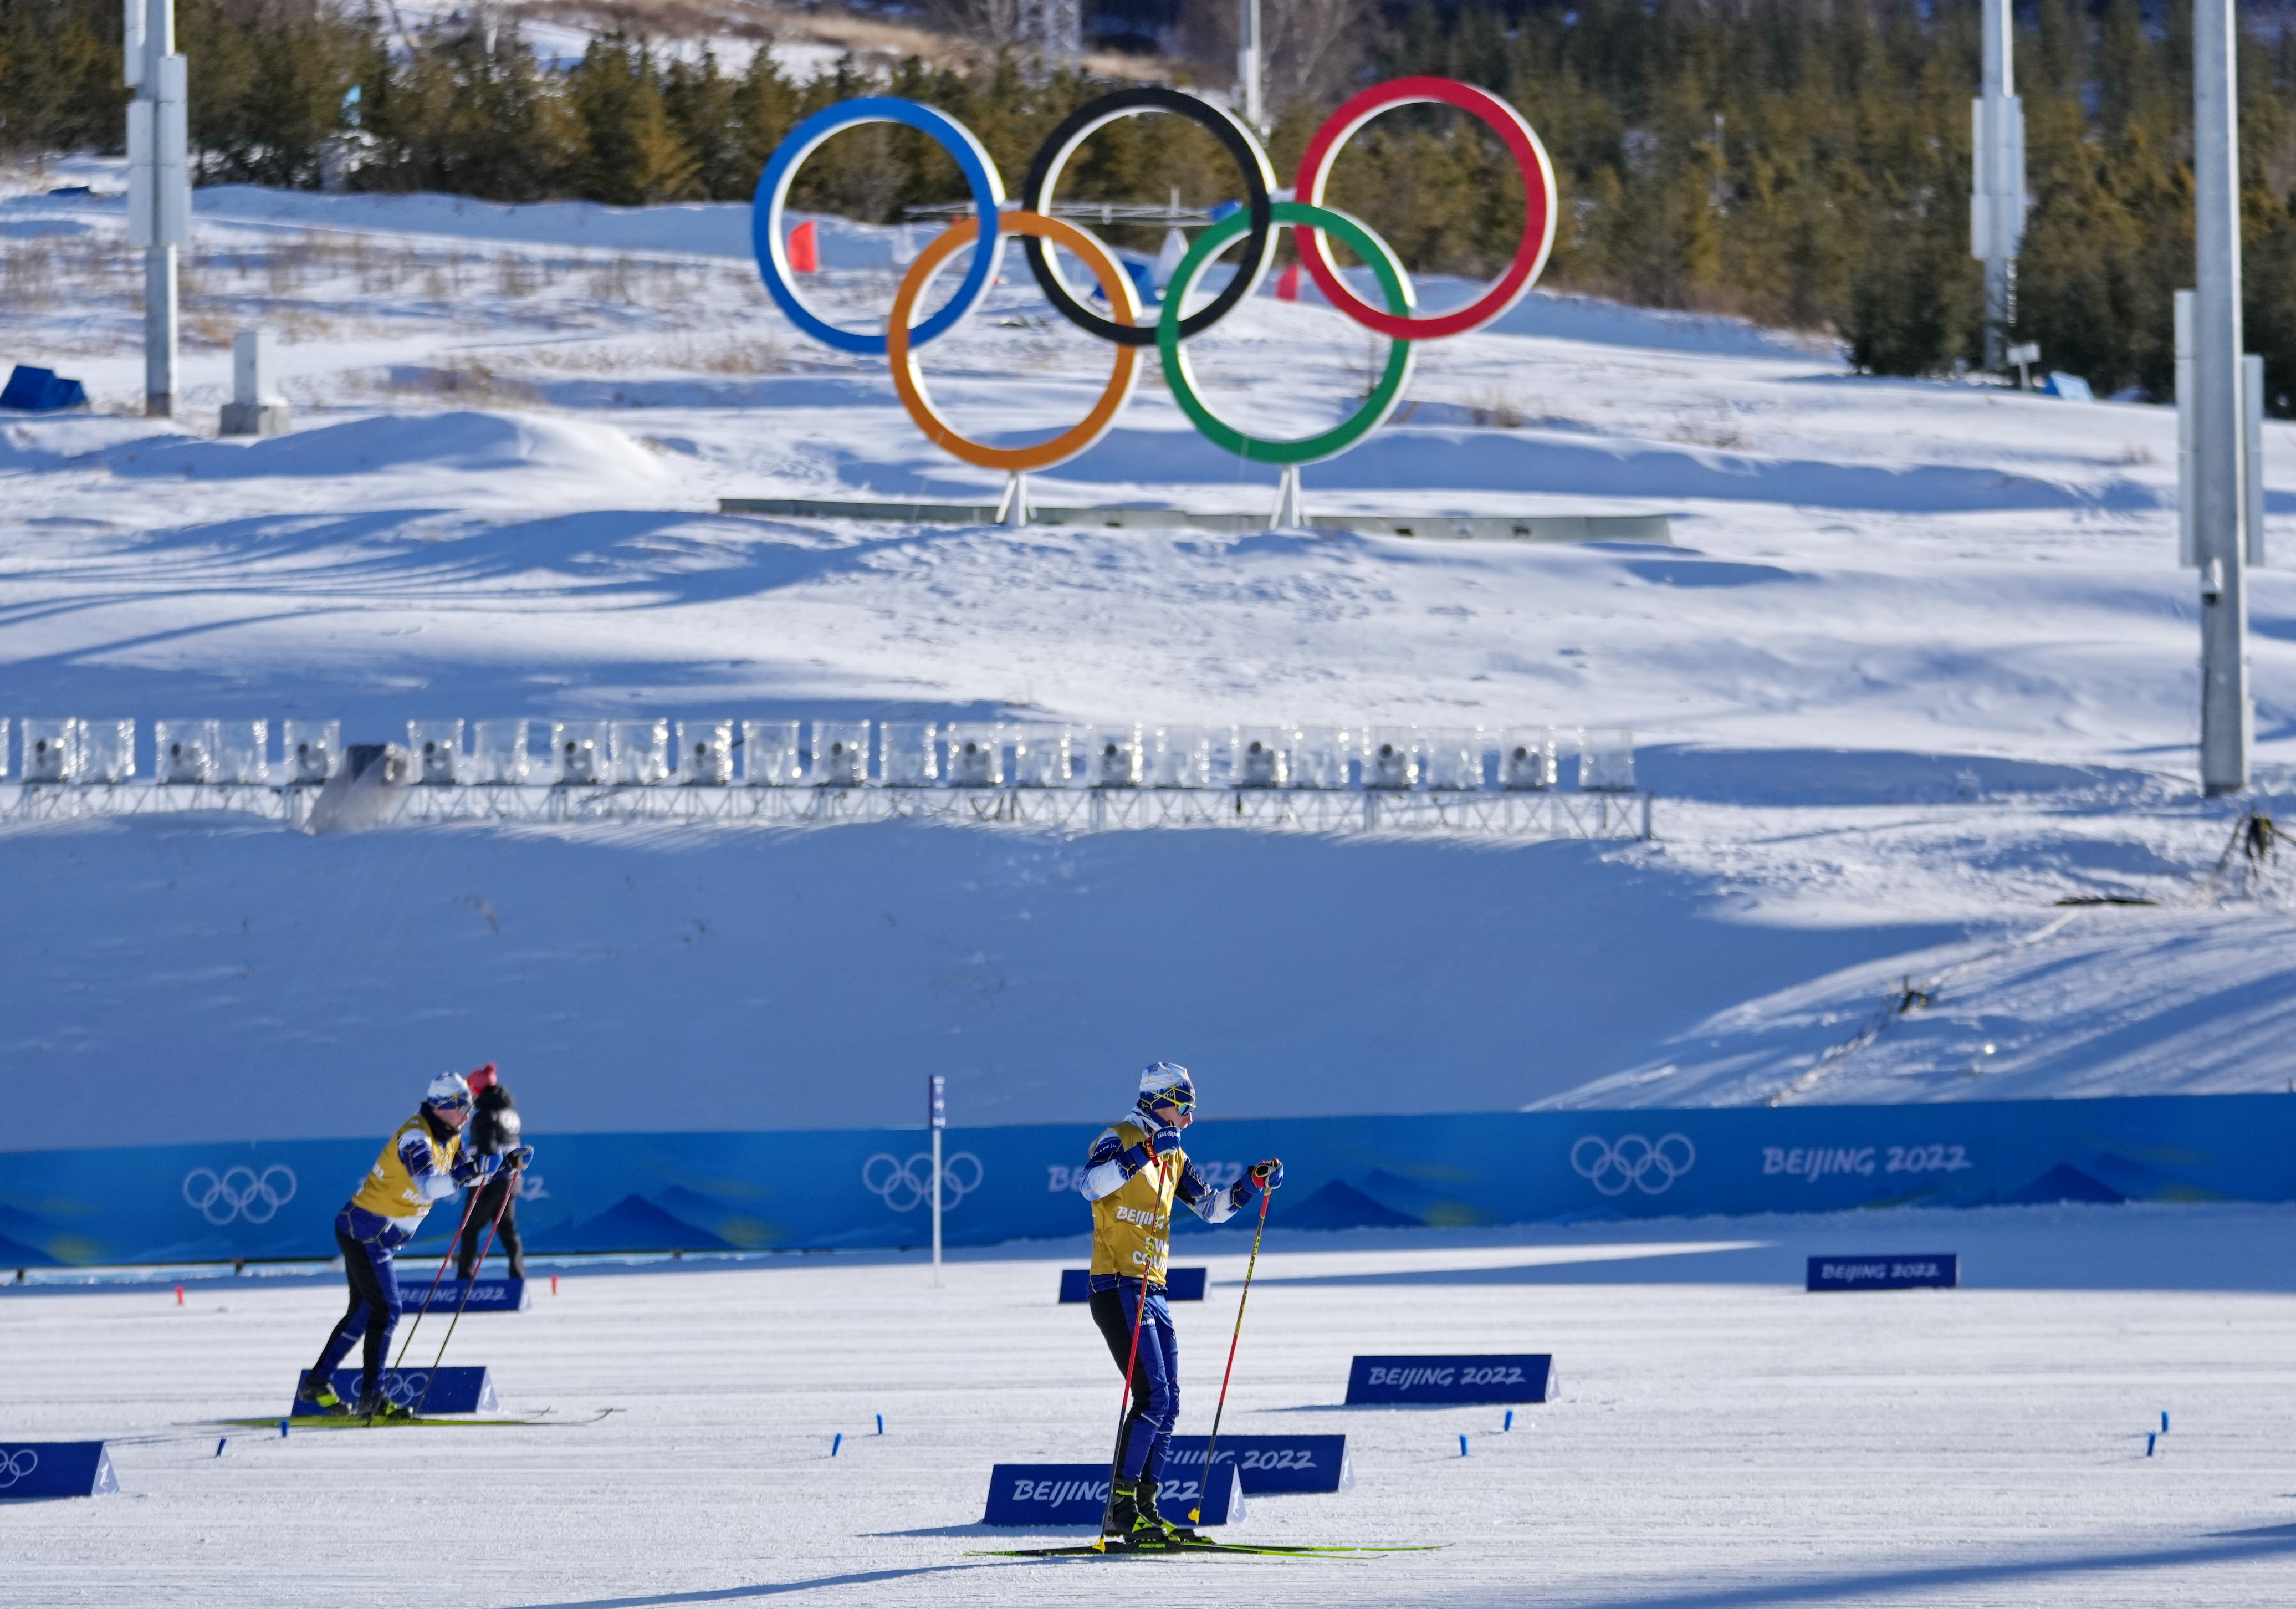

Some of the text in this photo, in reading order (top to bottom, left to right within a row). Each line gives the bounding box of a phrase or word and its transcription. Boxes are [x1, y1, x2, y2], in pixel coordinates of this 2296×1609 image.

[1762, 1143, 1973, 1182] BEIJING 2022
[1821, 1263, 1940, 1282] BEIJING 2022
[1368, 1366, 1526, 1391] BEIJING 2022
[1241, 1449, 1317, 1470] 2022
